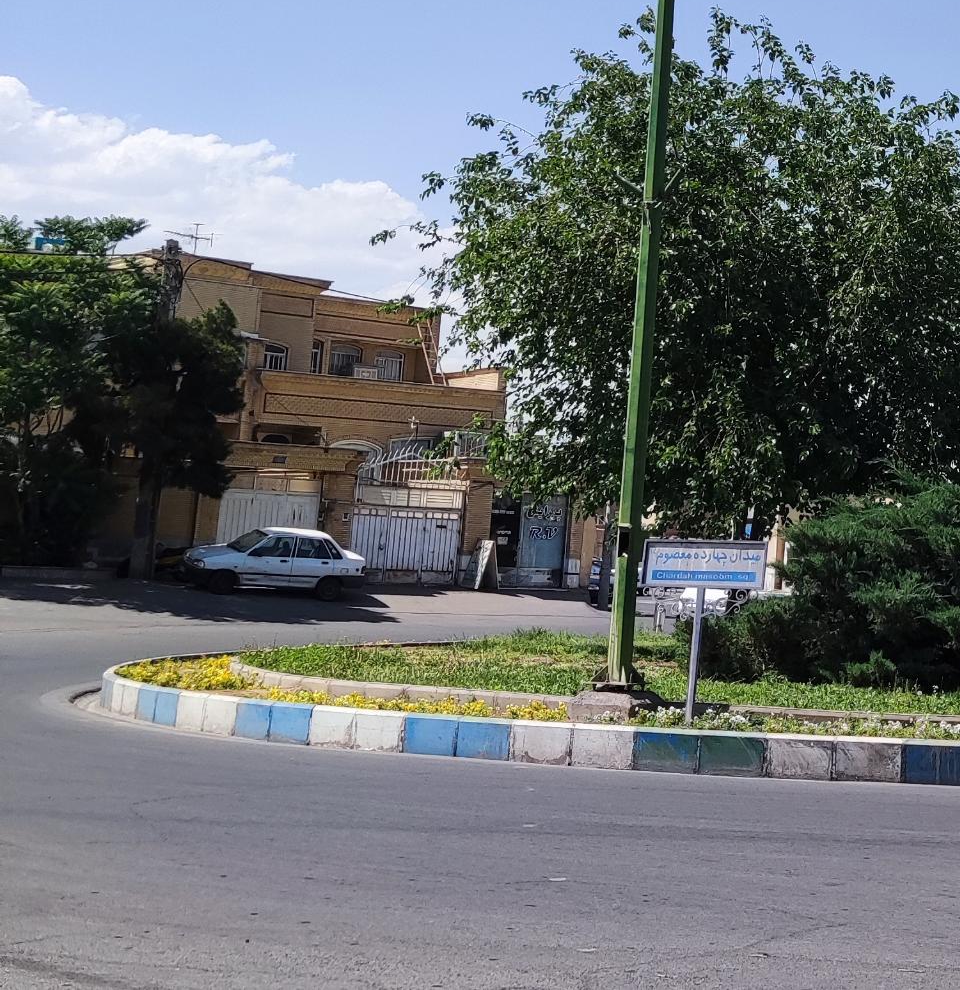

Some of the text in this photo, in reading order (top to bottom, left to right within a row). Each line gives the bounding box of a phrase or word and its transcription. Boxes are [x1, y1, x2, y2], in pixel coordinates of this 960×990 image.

[655, 550, 692, 565] معصوم
[694, 548, 727, 566] چهارده
[730, 549, 761, 565] میدان
